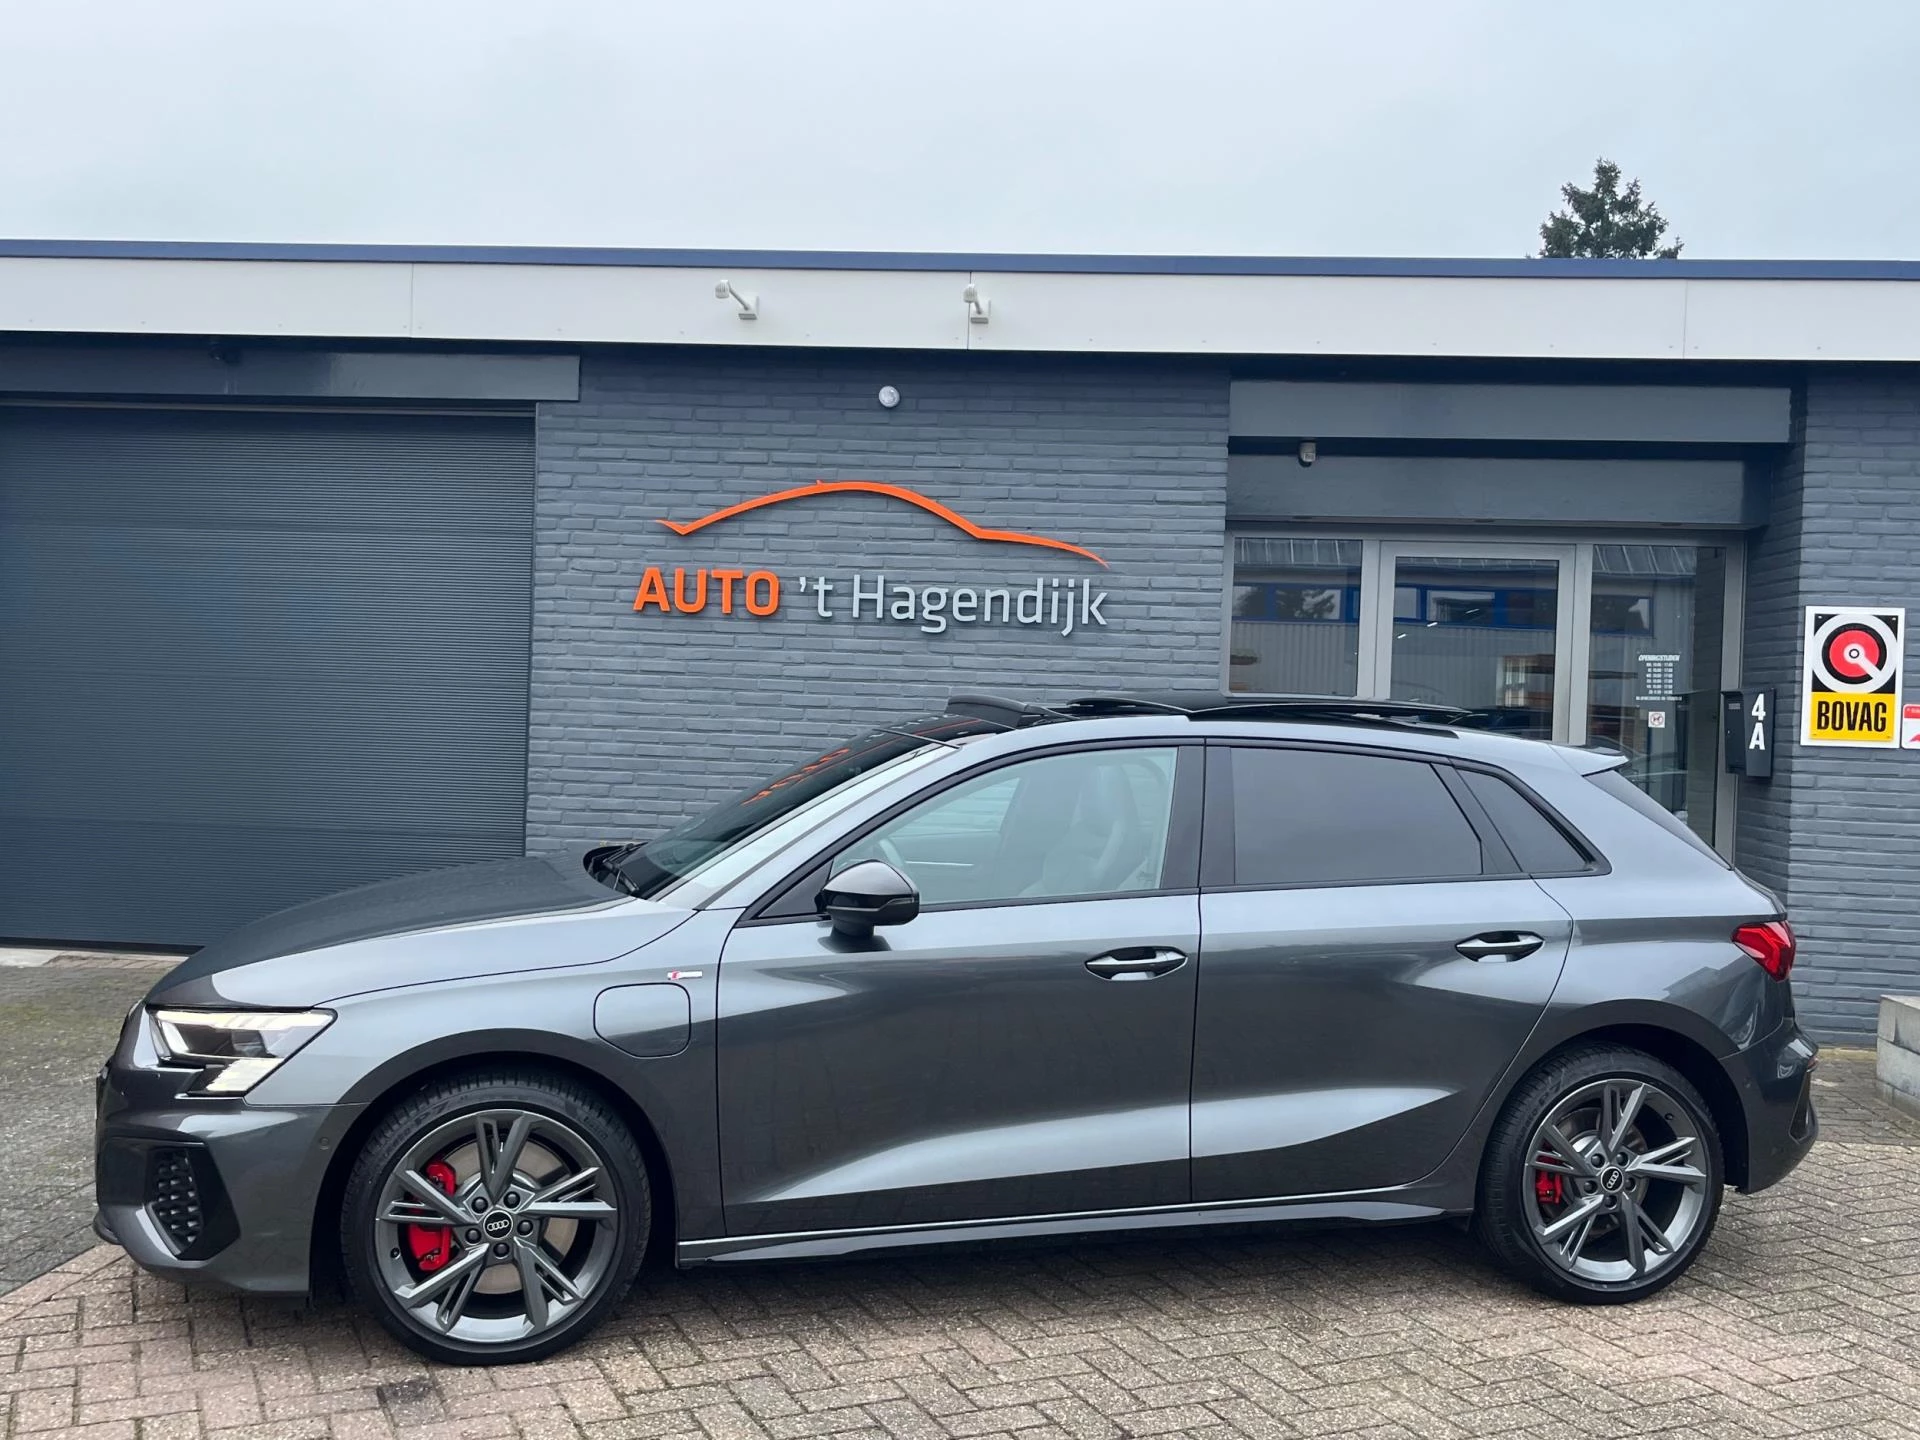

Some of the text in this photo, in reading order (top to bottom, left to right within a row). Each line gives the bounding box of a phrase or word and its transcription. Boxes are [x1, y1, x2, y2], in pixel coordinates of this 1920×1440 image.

[633, 567, 780, 616] AUTO
[852, 574, 1109, 637] Hagendijk
[1751, 693, 1767, 721] 4
[1816, 700, 1888, 732] BOVAG
[1748, 722, 1766, 751] A
